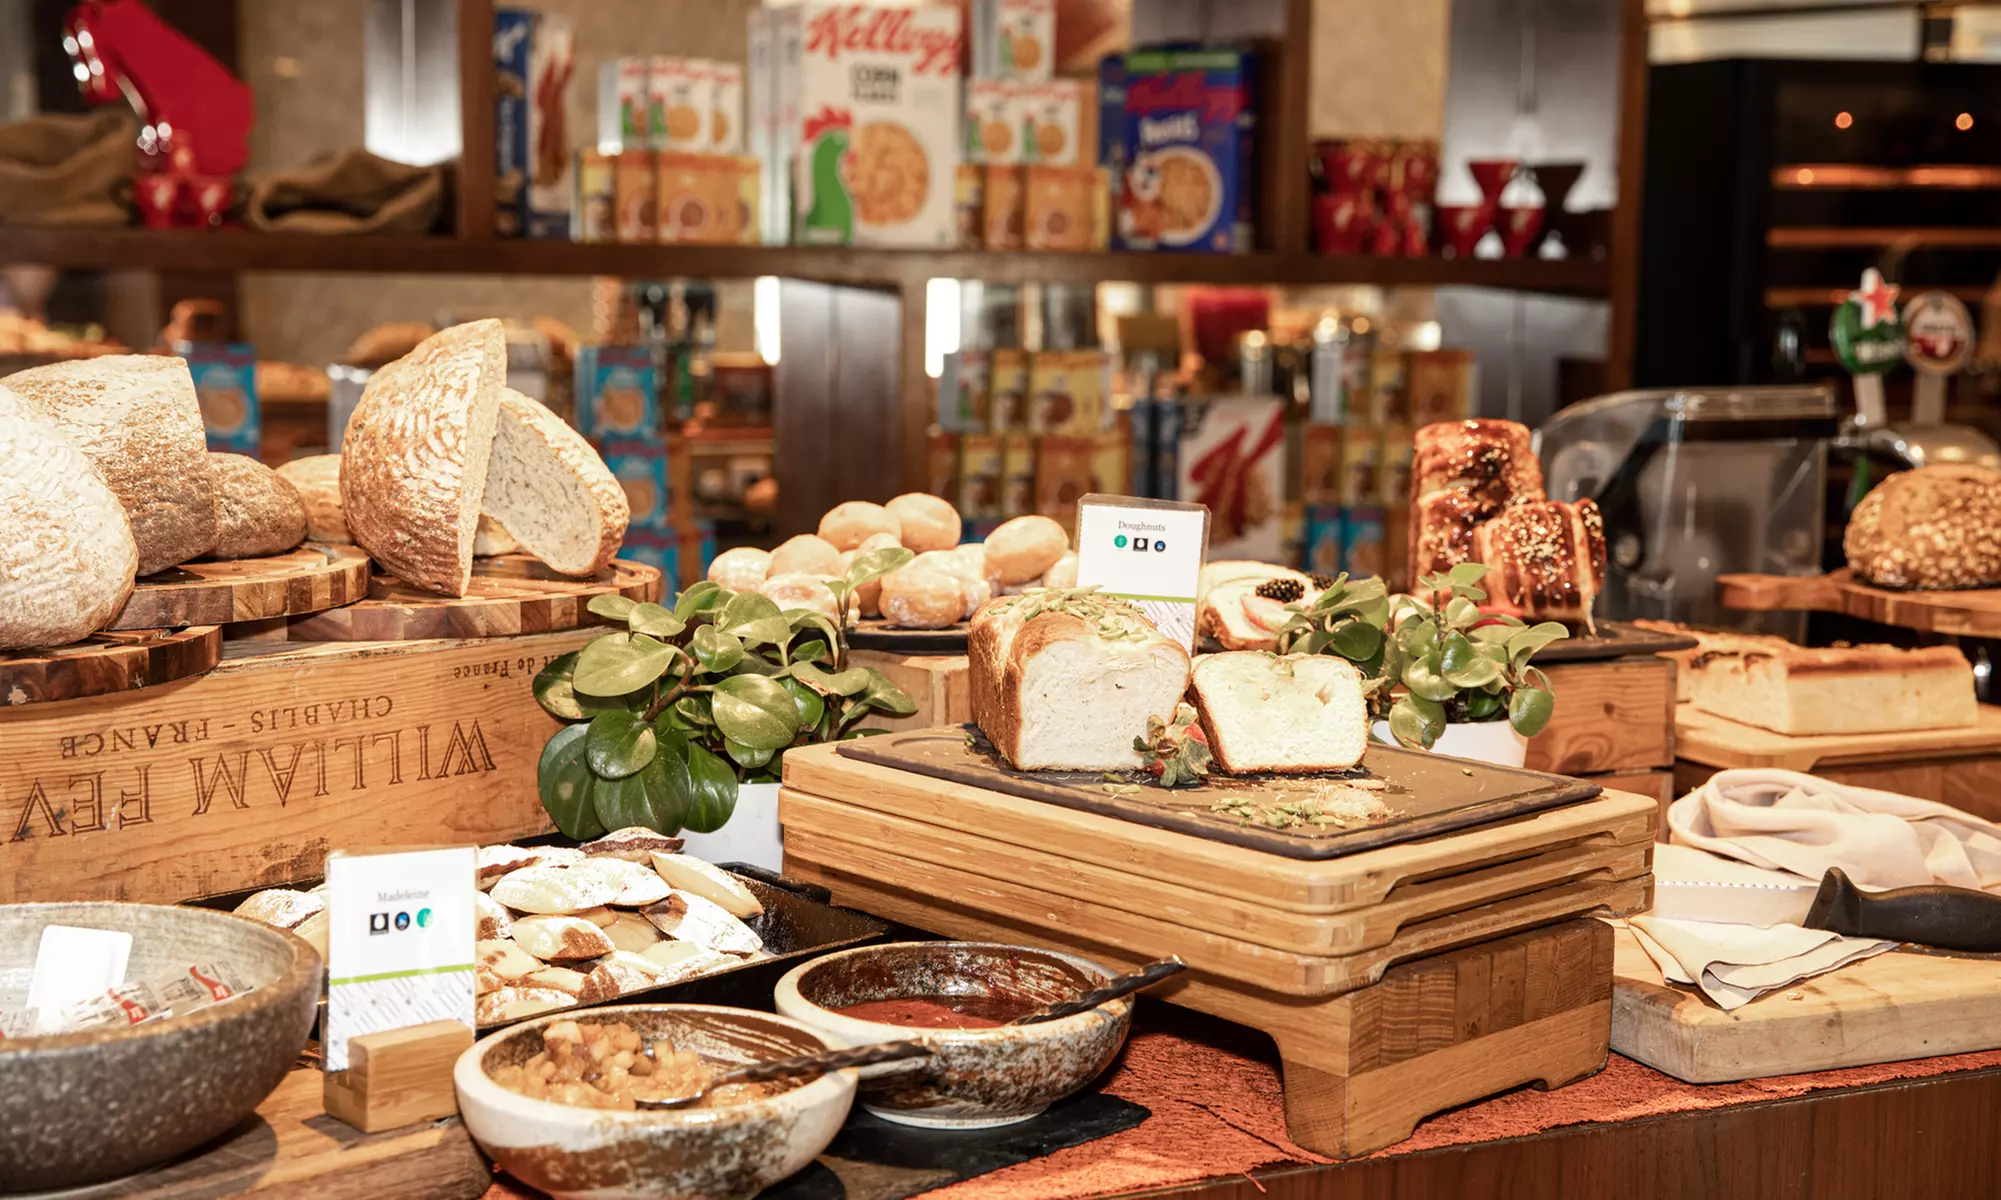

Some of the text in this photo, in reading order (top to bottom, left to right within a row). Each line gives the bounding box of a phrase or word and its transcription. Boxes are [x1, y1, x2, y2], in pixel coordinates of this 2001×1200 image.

[1118, 520, 1166, 532] Doughnuts
[453, 659, 512, 679] France
[250, 694, 393, 734] CHABLIS
[61, 717, 211, 760] FRANCE
[0, 717, 497, 846] WILLIAM FEV
[377, 888, 430, 903] Madeleine
